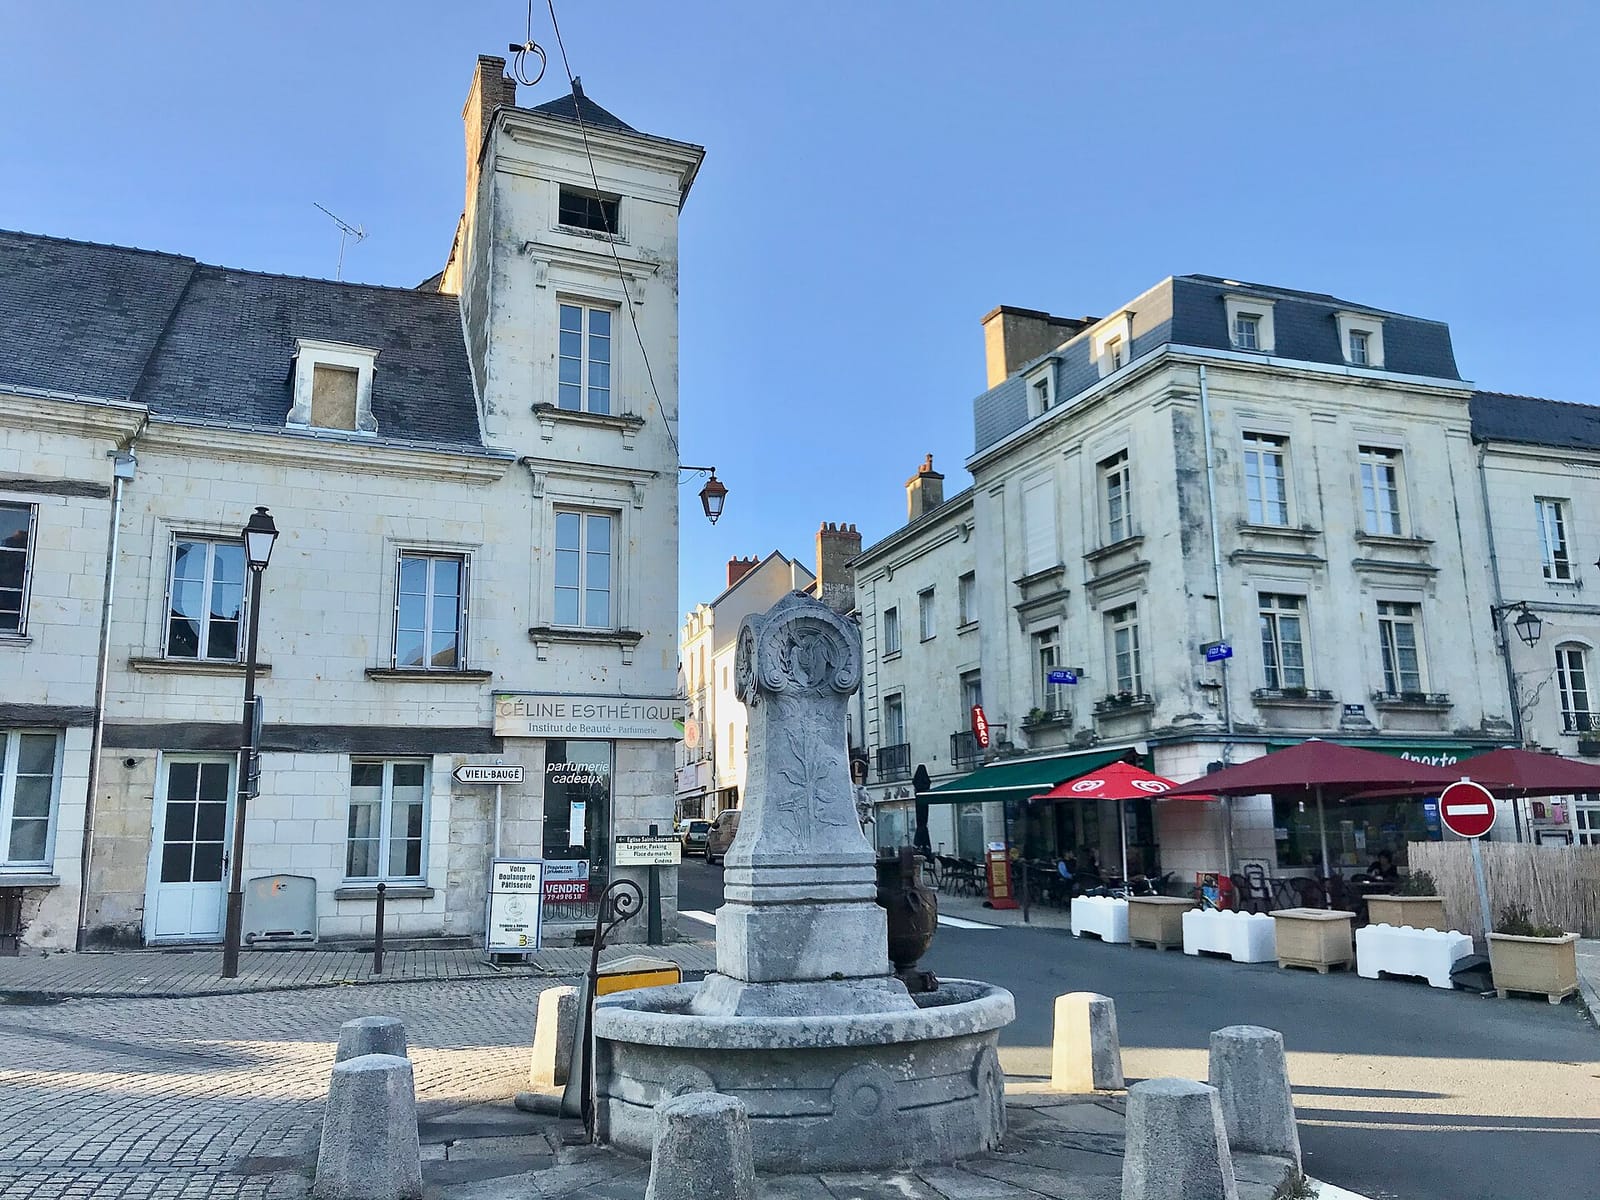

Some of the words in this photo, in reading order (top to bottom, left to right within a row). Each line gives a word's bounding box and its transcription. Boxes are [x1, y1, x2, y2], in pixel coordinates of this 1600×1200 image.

[500, 699, 566, 718] CÉLINE
[572, 702, 681, 720] ESTHÉTIQUE
[528, 722, 563, 733] Institut
[566, 723, 577, 733] de
[580, 723, 611, 734] Beauté
[618, 726, 657, 735] Parfumerie
[974, 708, 988, 744] TABAC
[546, 761, 609, 773] parfumerie
[465, 769, 520, 779] VIEIL-BAUGÉ
[552, 772, 603, 784] cadeaux
[498, 873, 536, 881] Boulangerie
[501, 881, 532, 889] Pâtisserie
[545, 884, 586, 894] VENDRE
